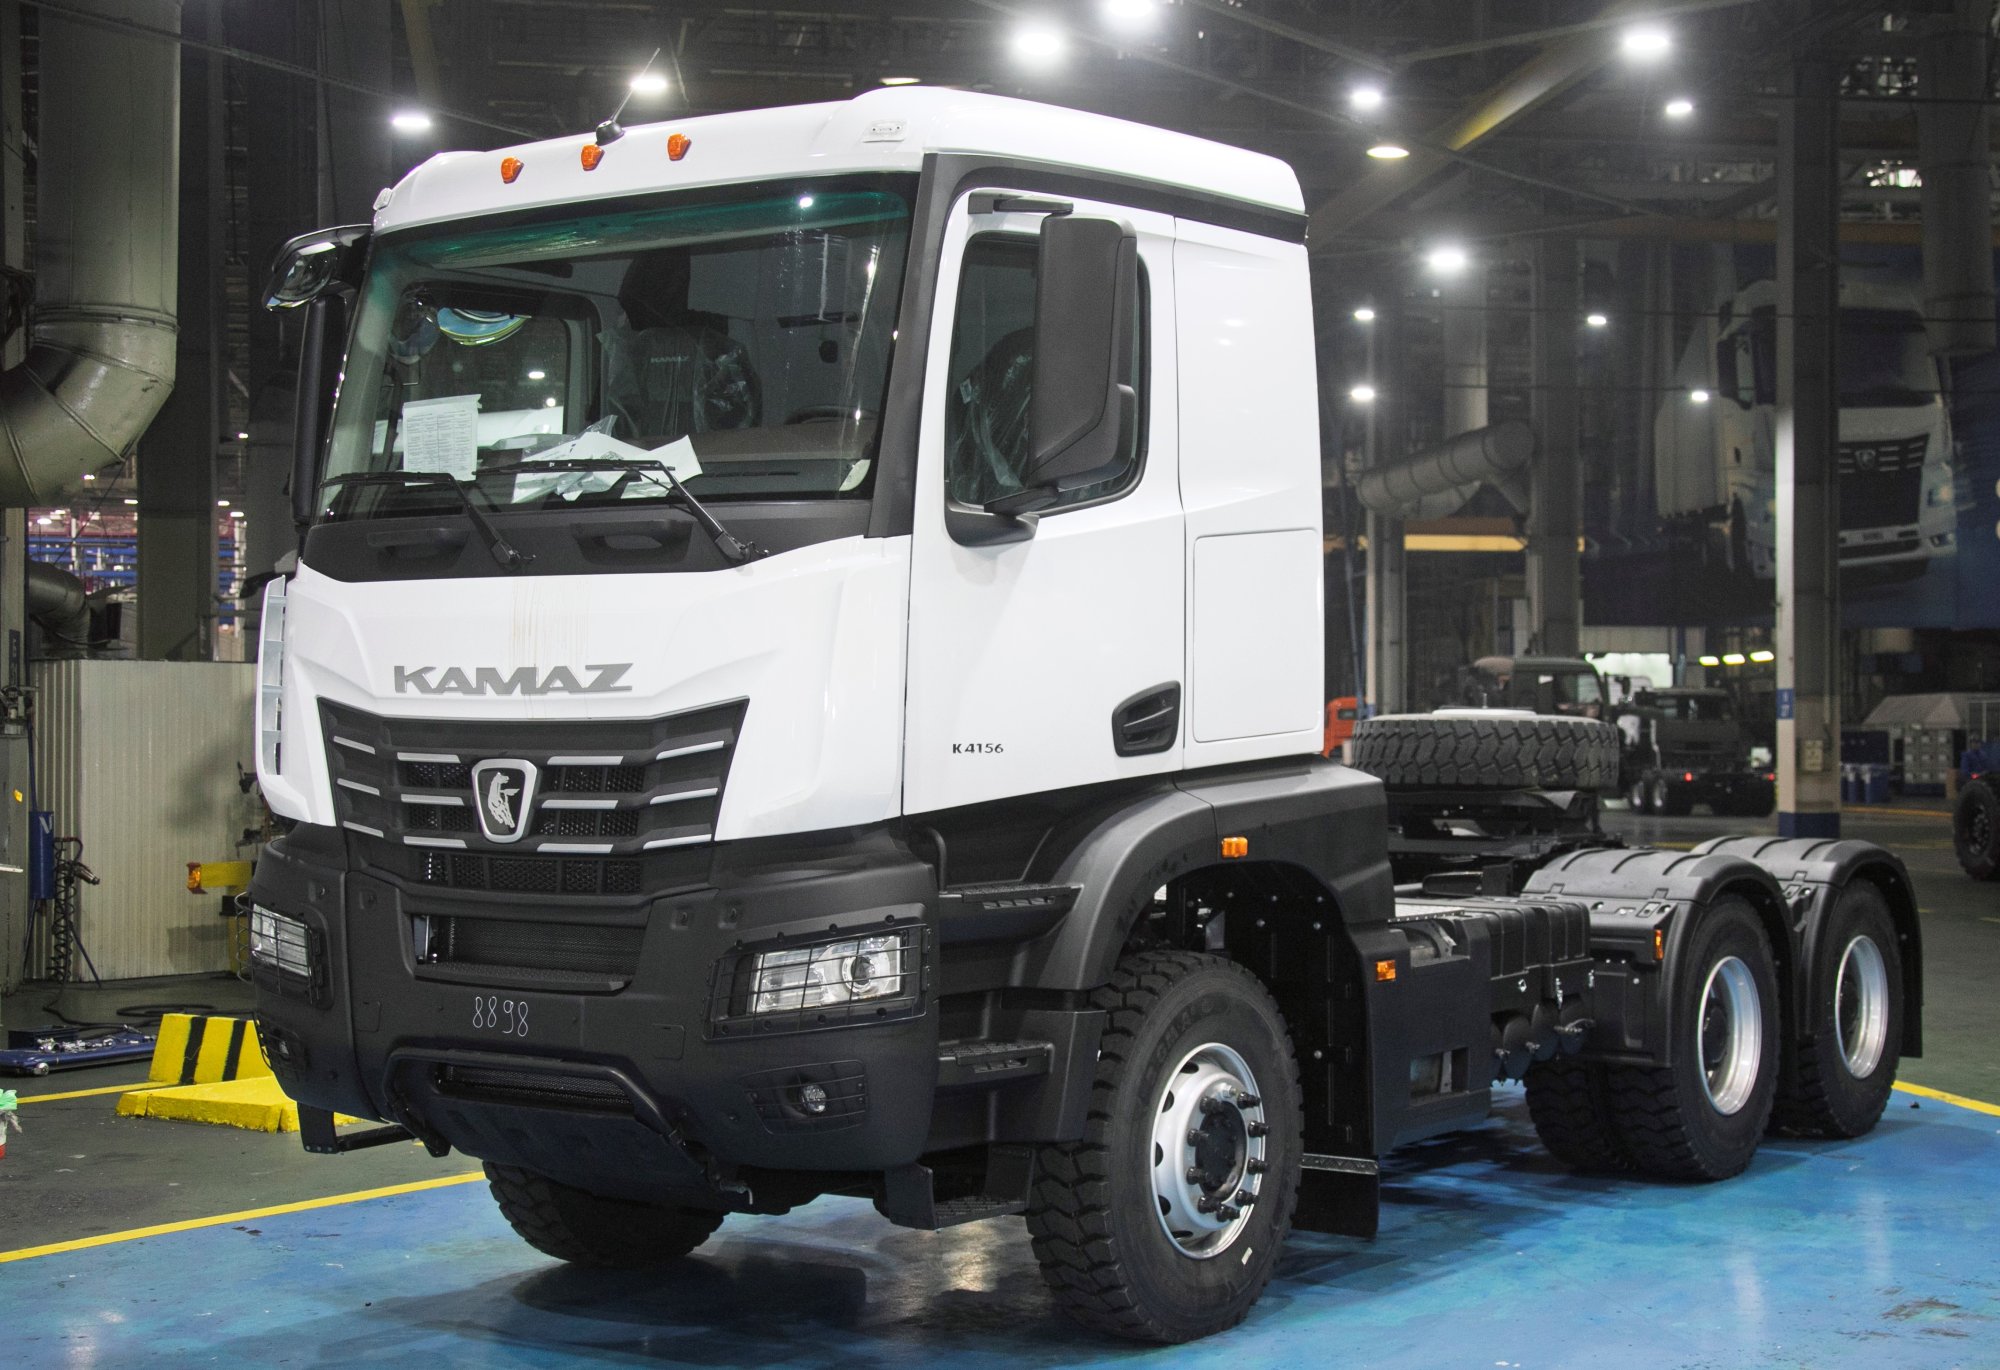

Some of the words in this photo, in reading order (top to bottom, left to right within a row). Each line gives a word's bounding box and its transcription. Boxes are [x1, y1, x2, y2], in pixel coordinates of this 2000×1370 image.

[393, 663, 634, 696] KAMAZ
[952, 743, 1004, 754] K4156
[472, 996, 529, 1037] 8898
